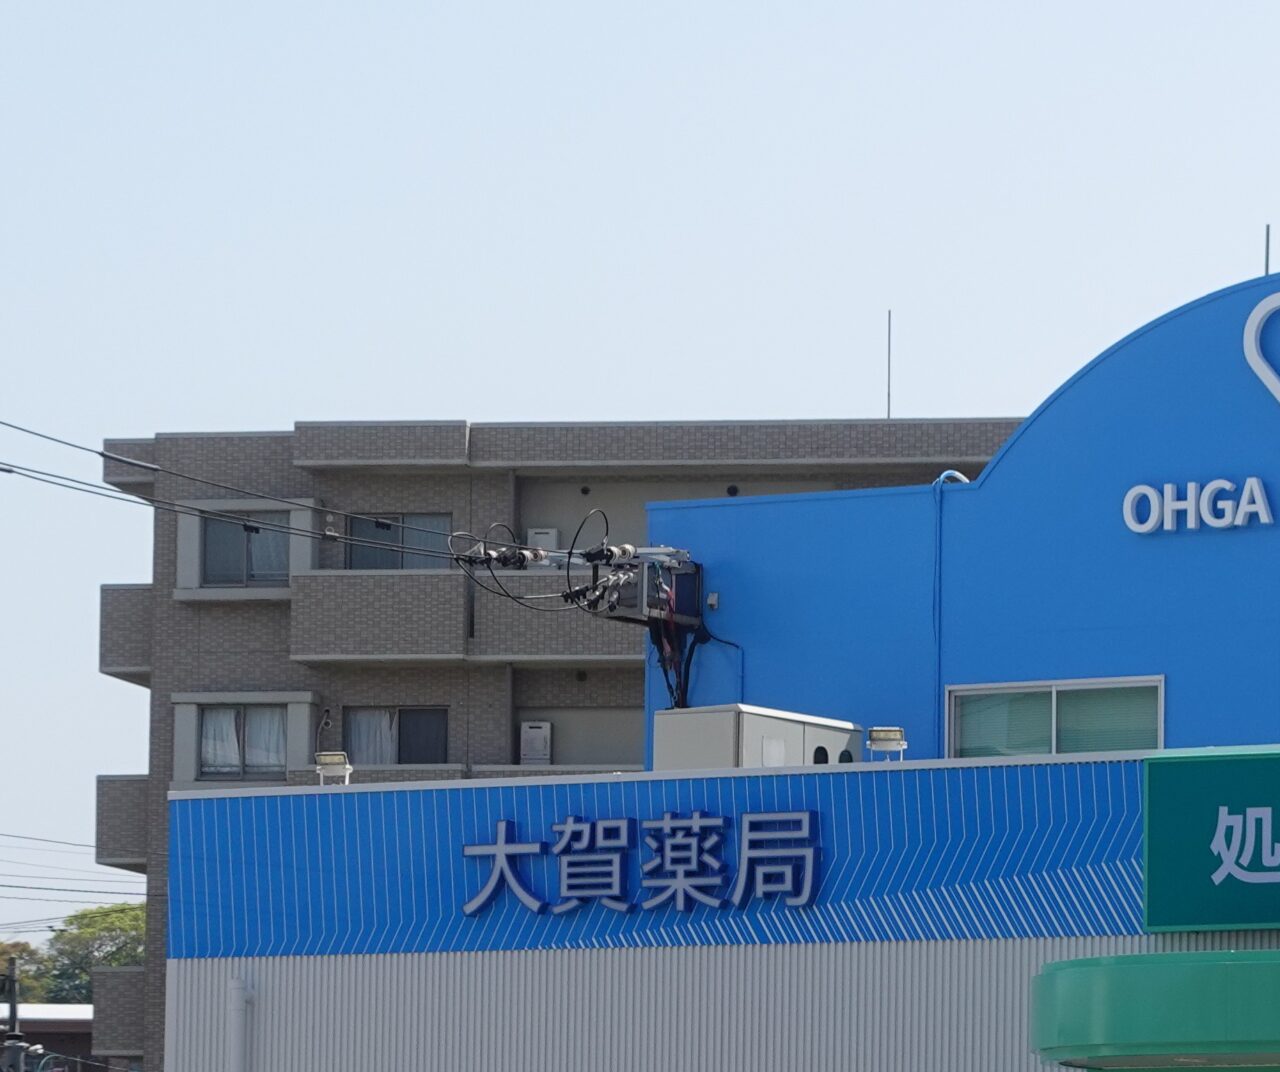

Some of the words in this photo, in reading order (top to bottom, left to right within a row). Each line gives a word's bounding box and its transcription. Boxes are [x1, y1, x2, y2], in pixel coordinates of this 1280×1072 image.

[1122, 476, 1273, 534] OHGA
[462, 809, 820, 917] 大賀薬局
